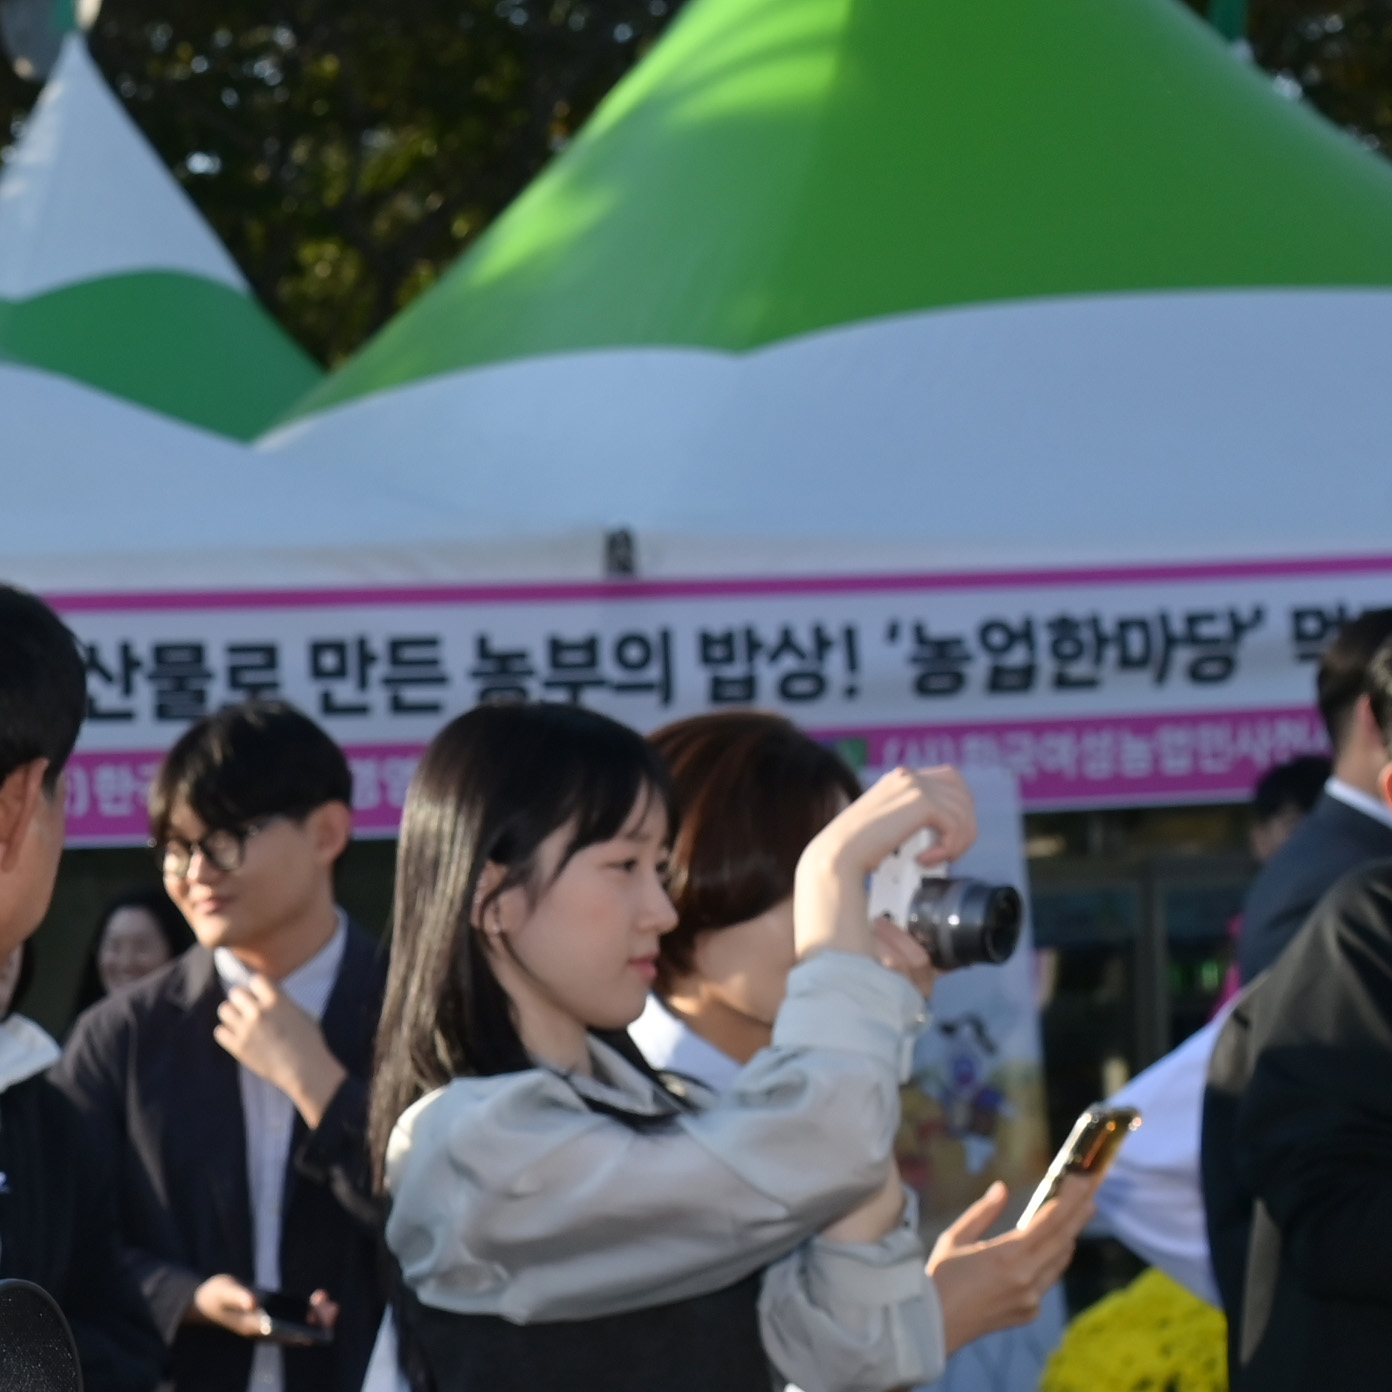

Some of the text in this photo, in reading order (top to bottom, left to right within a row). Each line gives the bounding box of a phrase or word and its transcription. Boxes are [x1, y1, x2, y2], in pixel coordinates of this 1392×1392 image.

[310, 635, 449, 716] 만든
[470, 628, 672, 706] 농부의
[699, 619, 859, 703] 밥상!
